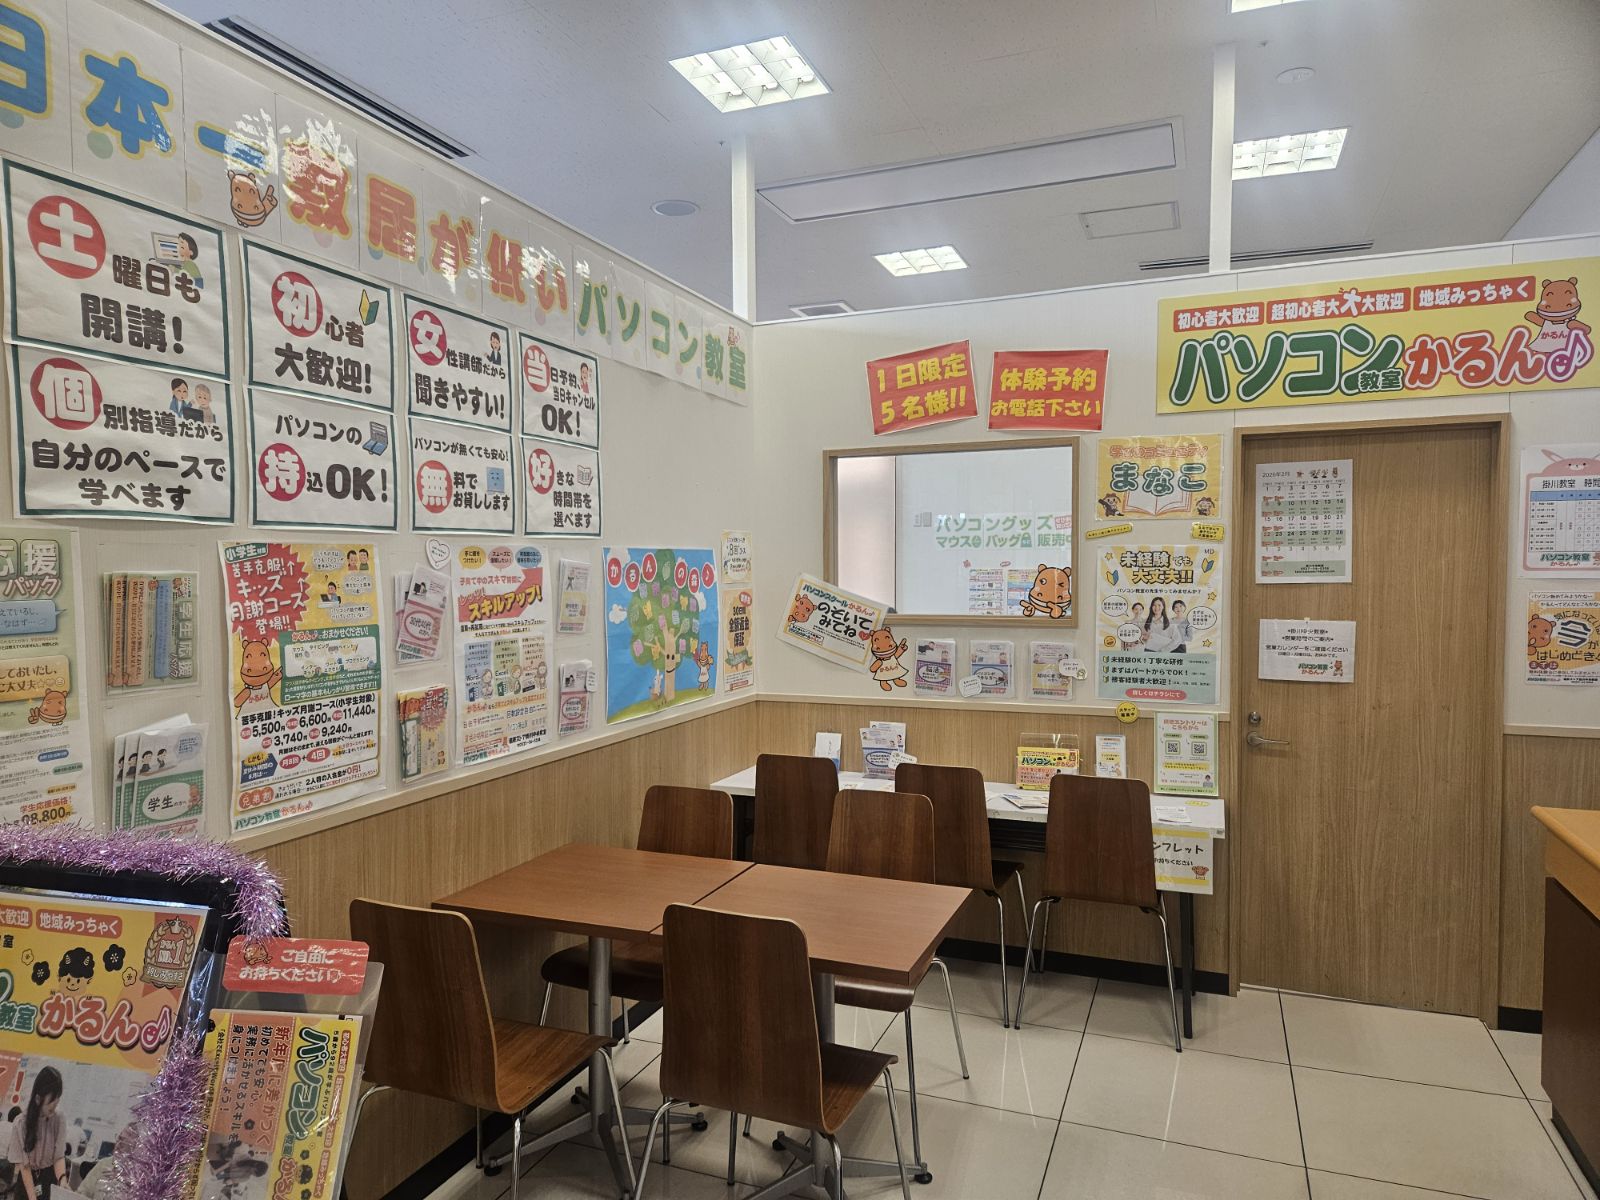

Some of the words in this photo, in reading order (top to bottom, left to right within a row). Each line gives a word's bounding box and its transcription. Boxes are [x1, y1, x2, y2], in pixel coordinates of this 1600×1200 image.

[36, 200, 101, 274] 土
[113, 255, 201, 304] 曜日も
[82, 293, 185, 354] 開講!
[275, 275, 318, 336] 初
[325, 315, 365, 348] 心者
[1177, 304, 1260, 331] 初心者大歓迎
[1418, 282, 1530, 309] 地域みっちゃく
[411, 311, 449, 365] 女
[274, 342, 372, 395] 大歓迎!
[526, 349, 551, 388] 当
[1000, 367, 1098, 391] 体験予約
[1171, 324, 1405, 405] パソコン
[1358, 369, 1404, 392] 教室
[36, 364, 97, 425] 個
[103, 403, 225, 442] 別指導だから
[415, 373, 505, 420] 聞きやすい!
[991, 398, 1101, 418] お電話下さい
[275, 415, 362, 445] パソコンの
[31, 439, 227, 482] 自分のペースで
[262, 448, 306, 497] 持
[528, 452, 550, 488] 好
[555, 470, 574, 486] きな
[78, 478, 192, 511] 学べます
[421, 466, 452, 507] 無
[453, 472, 477, 490] 料で
[1110, 461, 1207, 497] まなこ
[453, 489, 510, 512] お貸しします
[553, 490, 592, 510] 時間帯を
[552, 511, 593, 529] 選べます
[936, 514, 1053, 533] パソコングッズ
[936, 536, 971, 548] マウス
[985, 536, 1020, 548] バッグ
[1540, 553, 1591, 562] パソコン教室
[1120, 551, 1194, 568] 未経験でも
[1132, 569, 1194, 584] 大丈夫!!
[3, 575, 61, 598] パック
[236, 575, 284, 600] キッズ
[468, 584, 543, 623] スキルアップ!
[230, 592, 306, 622] 月謝コース
[818, 615, 857, 638] みてね
[0, 908, 30, 926] 歓迎
[39, 912, 117, 935] 地域みっちゃく
[281, 949, 334, 964] ご自由に
[229, 1025, 259, 1141] 実務に活かせるスキルを
[285, 1026, 329, 1139] パソコン
